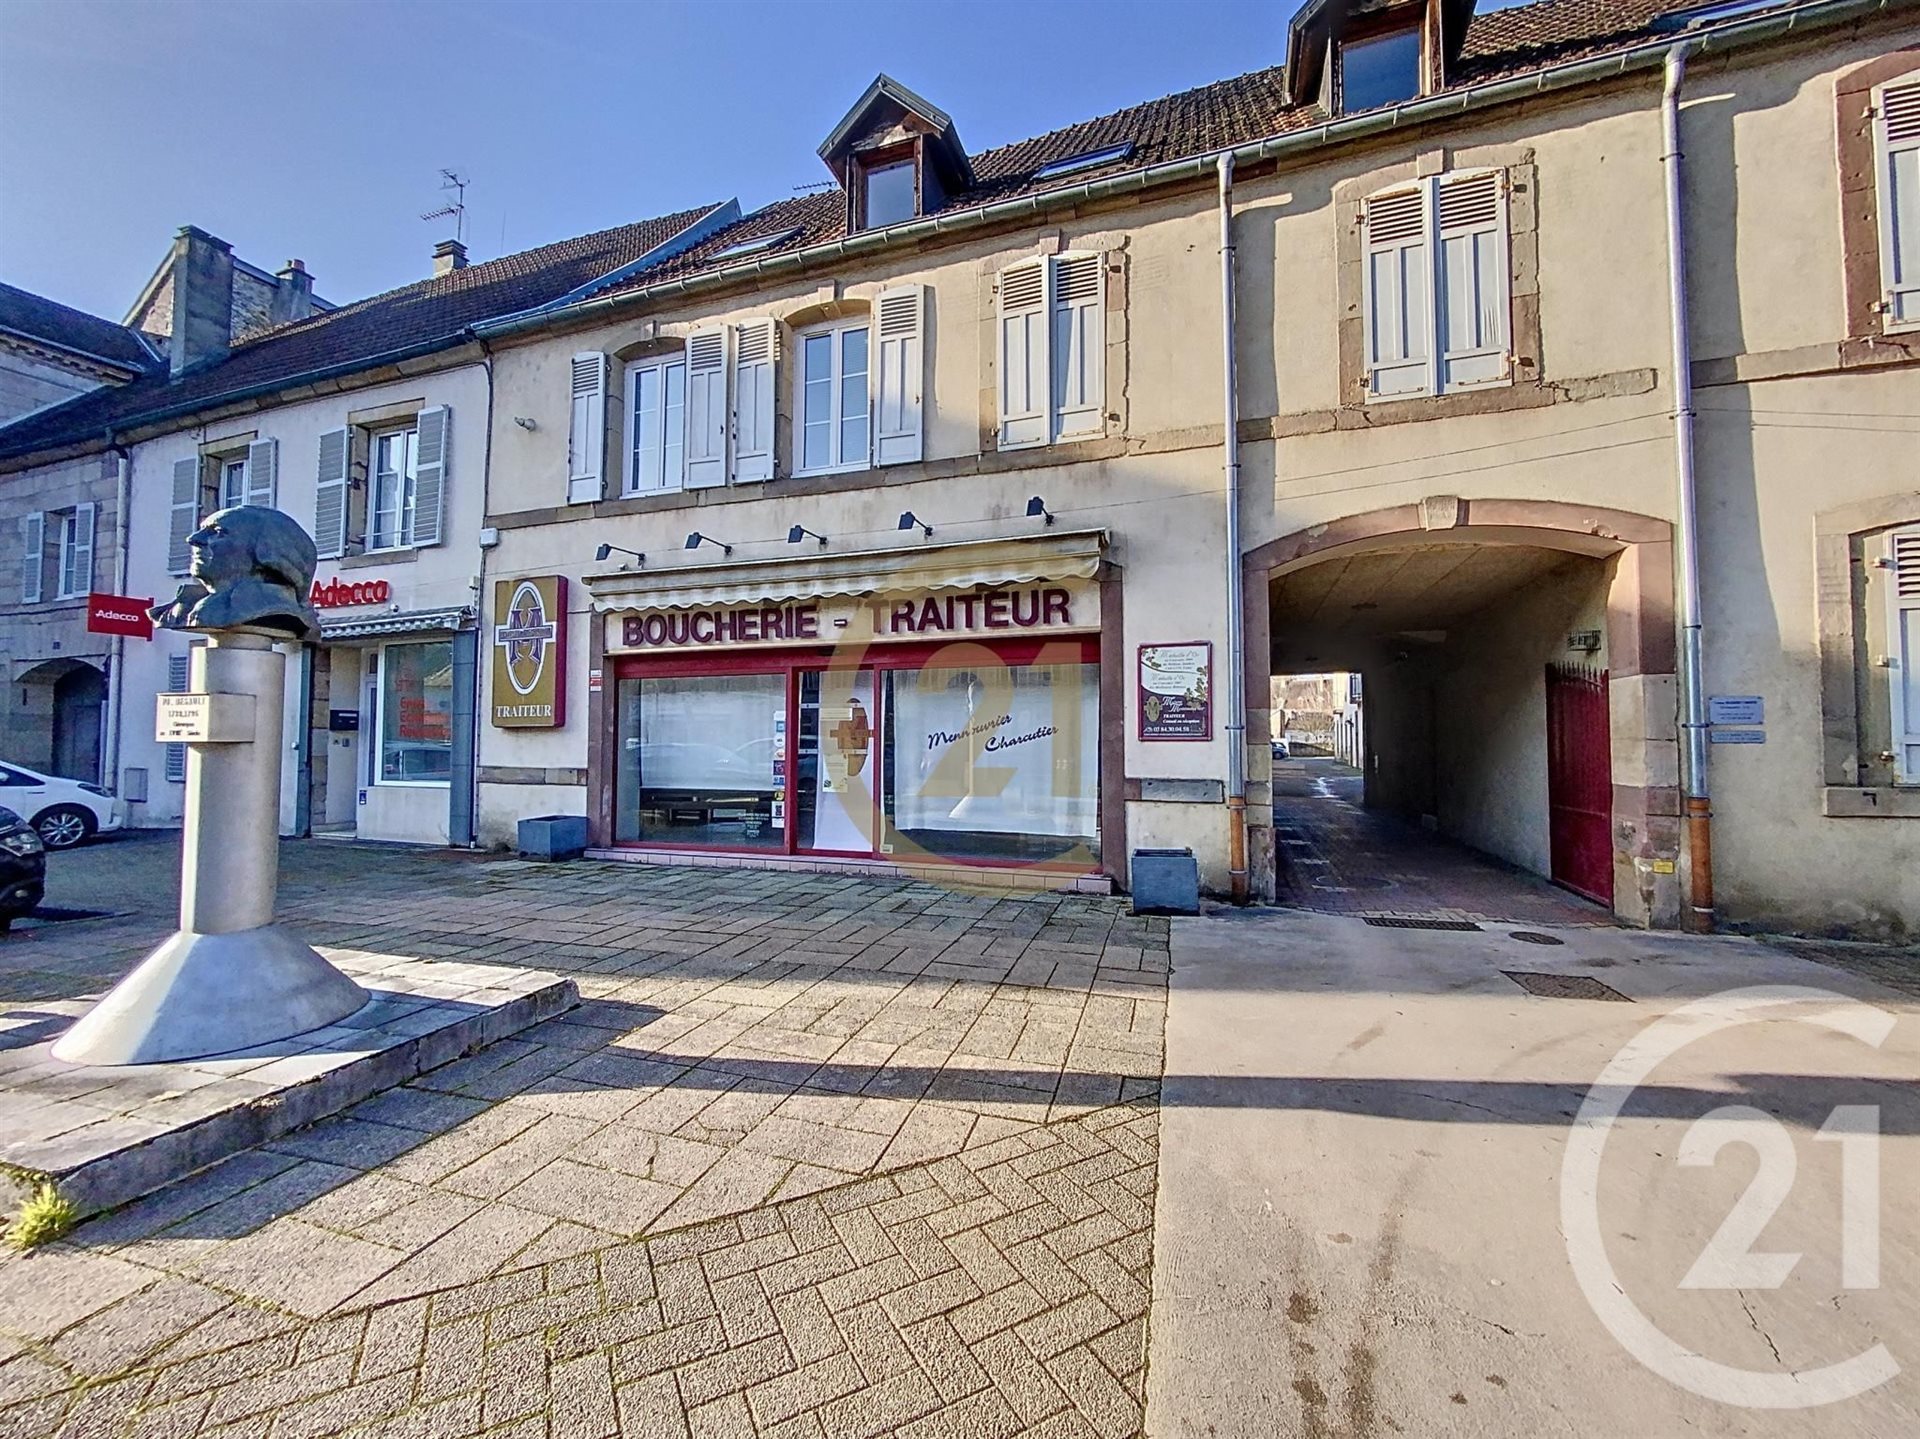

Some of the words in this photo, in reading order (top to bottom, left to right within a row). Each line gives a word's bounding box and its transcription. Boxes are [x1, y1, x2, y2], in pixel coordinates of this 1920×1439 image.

[310, 577, 389, 607] Adecco
[95, 609, 139, 623] Adecco
[622, 604, 818, 646] BOUCHERIE
[865, 587, 1071, 634] TRAITEUR
[496, 704, 552, 718] TRAITEUR
[985, 726, 1059, 752] Charcutier
